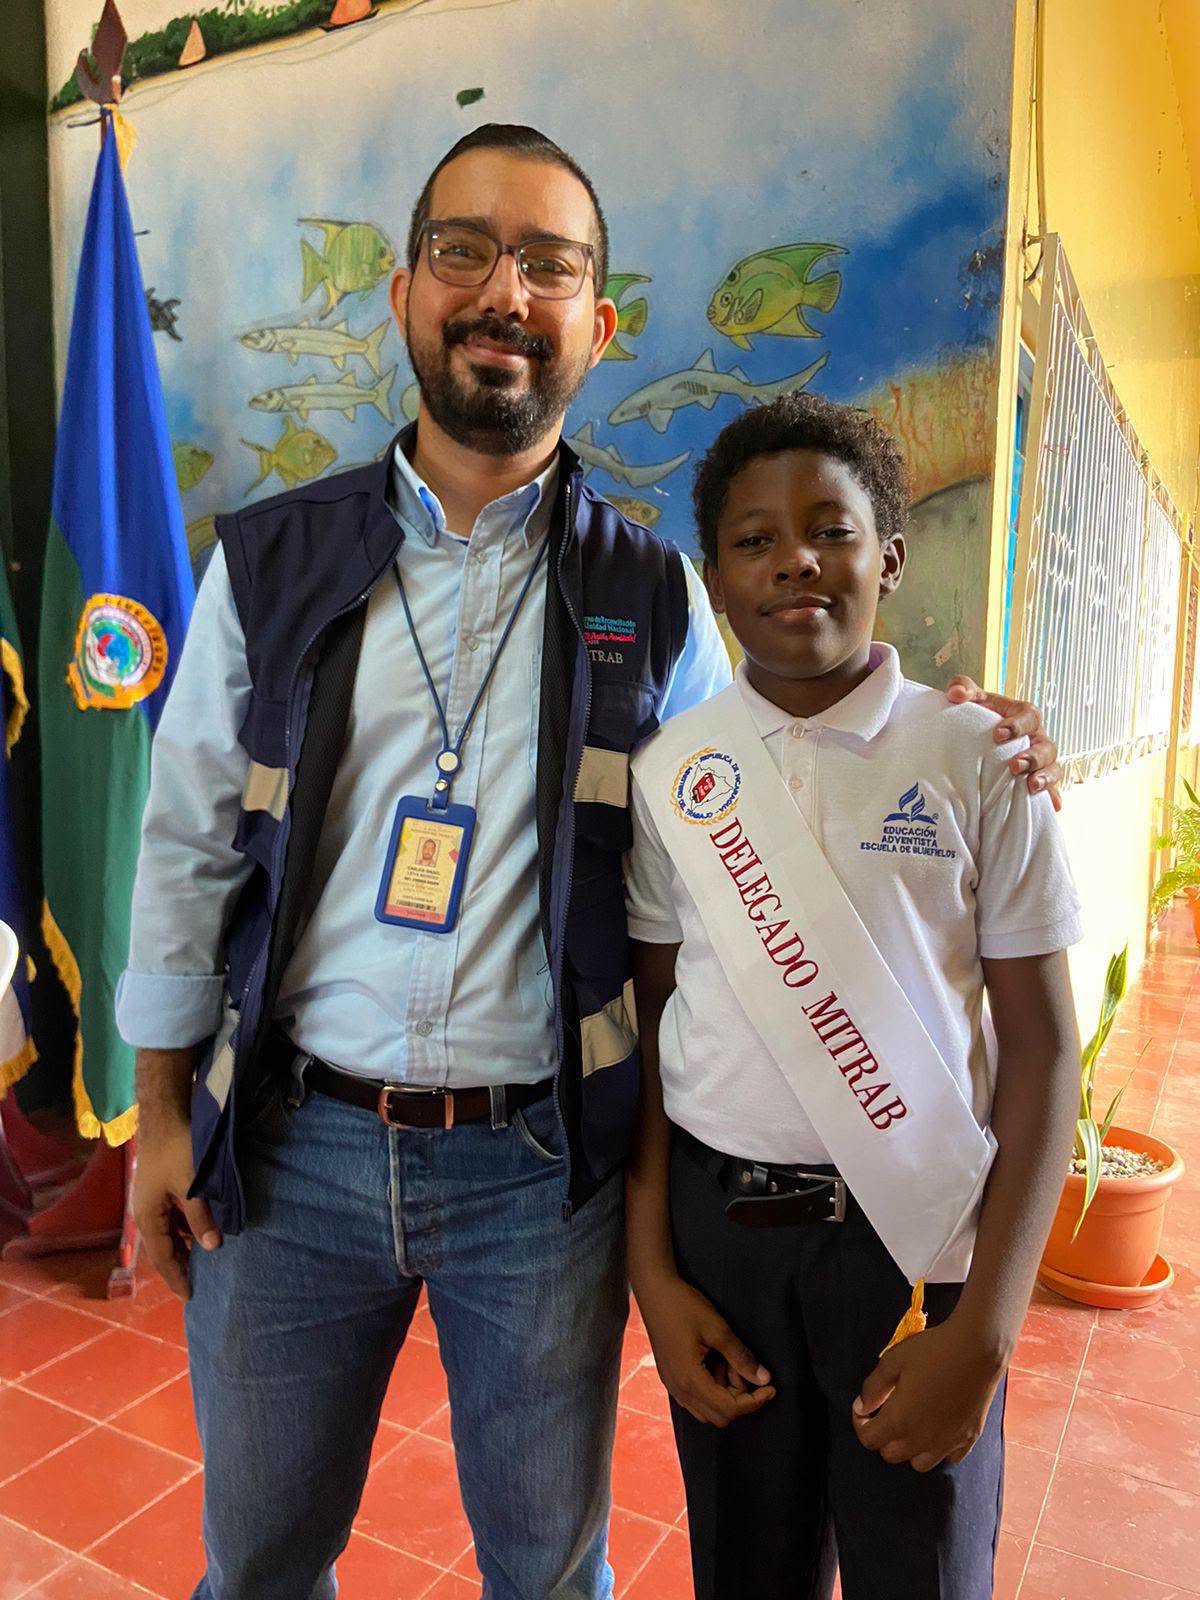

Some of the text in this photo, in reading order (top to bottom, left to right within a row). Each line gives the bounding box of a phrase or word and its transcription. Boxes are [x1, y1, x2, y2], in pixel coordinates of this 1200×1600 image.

[589, 649, 624, 664] TRAB
[685, 808, 713, 819] TRABAJO
[883, 826, 937, 839] EDUCACIÓN
[881, 835, 938, 848] ADVENTISTA
[860, 842, 956, 859] ESCUELA DE BLUEFIELDS
[709, 817, 908, 1130] DELEGADO MITRAB
